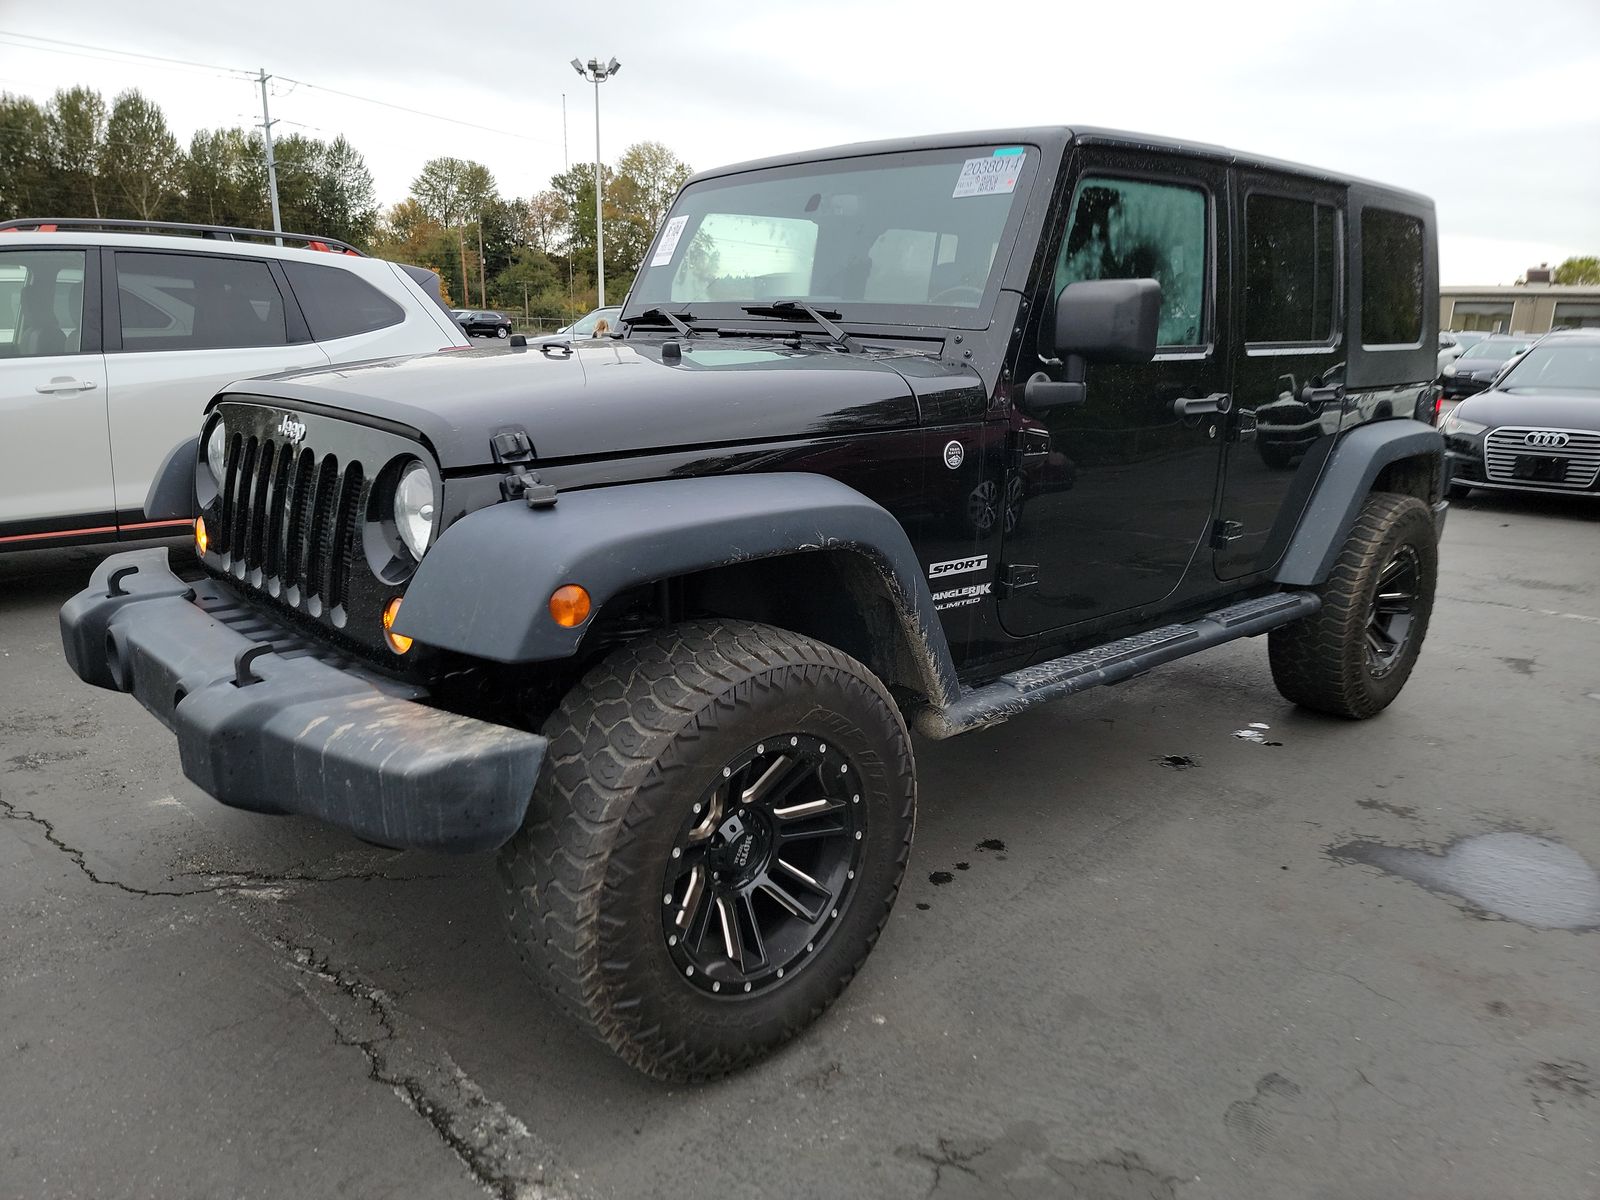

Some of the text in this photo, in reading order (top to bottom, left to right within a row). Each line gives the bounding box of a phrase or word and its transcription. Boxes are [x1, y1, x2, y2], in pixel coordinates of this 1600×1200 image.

[278, 415, 306, 444] Jeep
[930, 558, 987, 574] SPORT
[935, 597, 980, 610] NLIMITED
[740, 835, 753, 866] MOTO
